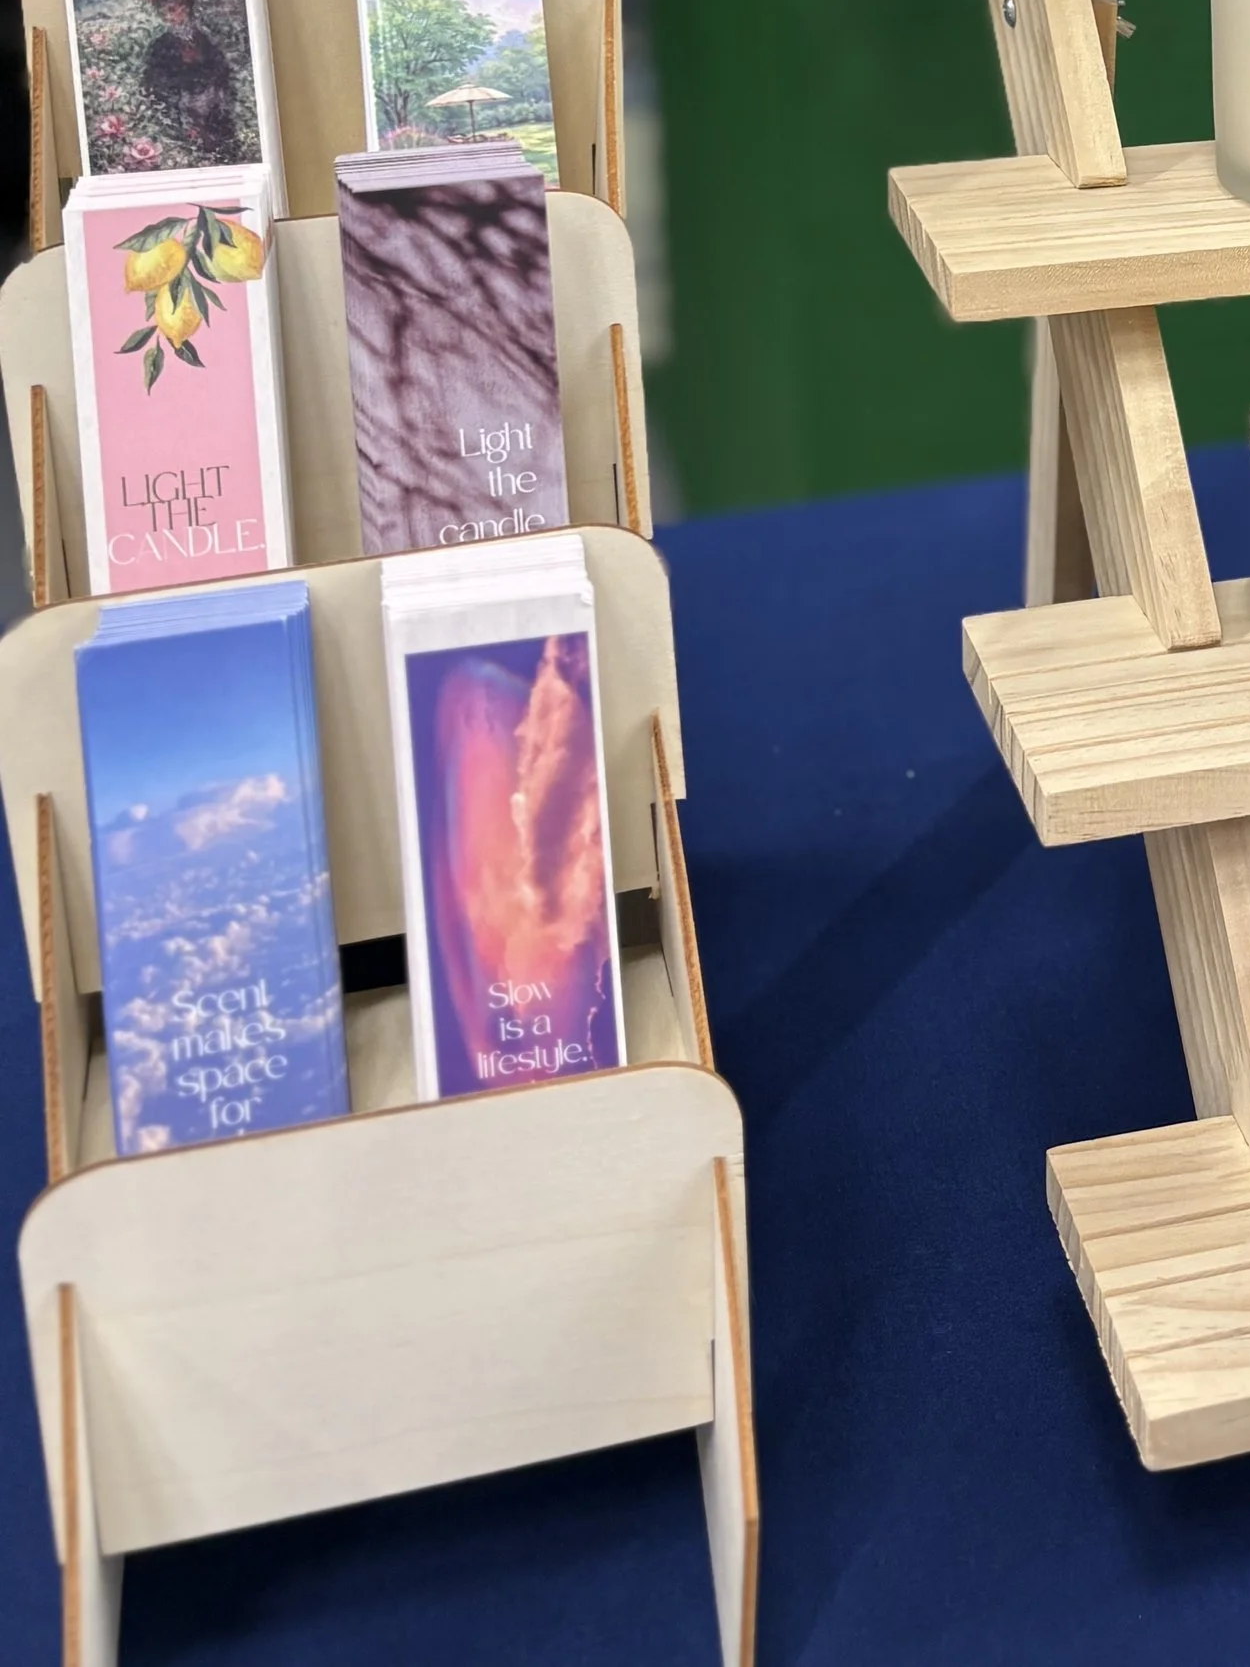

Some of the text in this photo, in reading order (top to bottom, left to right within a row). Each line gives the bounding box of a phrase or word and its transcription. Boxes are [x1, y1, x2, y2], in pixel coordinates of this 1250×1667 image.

[459, 422, 533, 463] Light
[121, 466, 229, 506] LIGHT
[489, 467, 537, 497] the
[150, 496, 216, 532] THE
[108, 519, 266, 565] CANDLE.
[172, 978, 268, 1022] Scent
[488, 980, 552, 1009] Slow
[172, 1016, 287, 1061] makes
[500, 1014, 551, 1041] is a
[178, 1055, 288, 1102] space
[477, 1039, 587, 1079] lifestyle.
[210, 1096, 262, 1129] for
